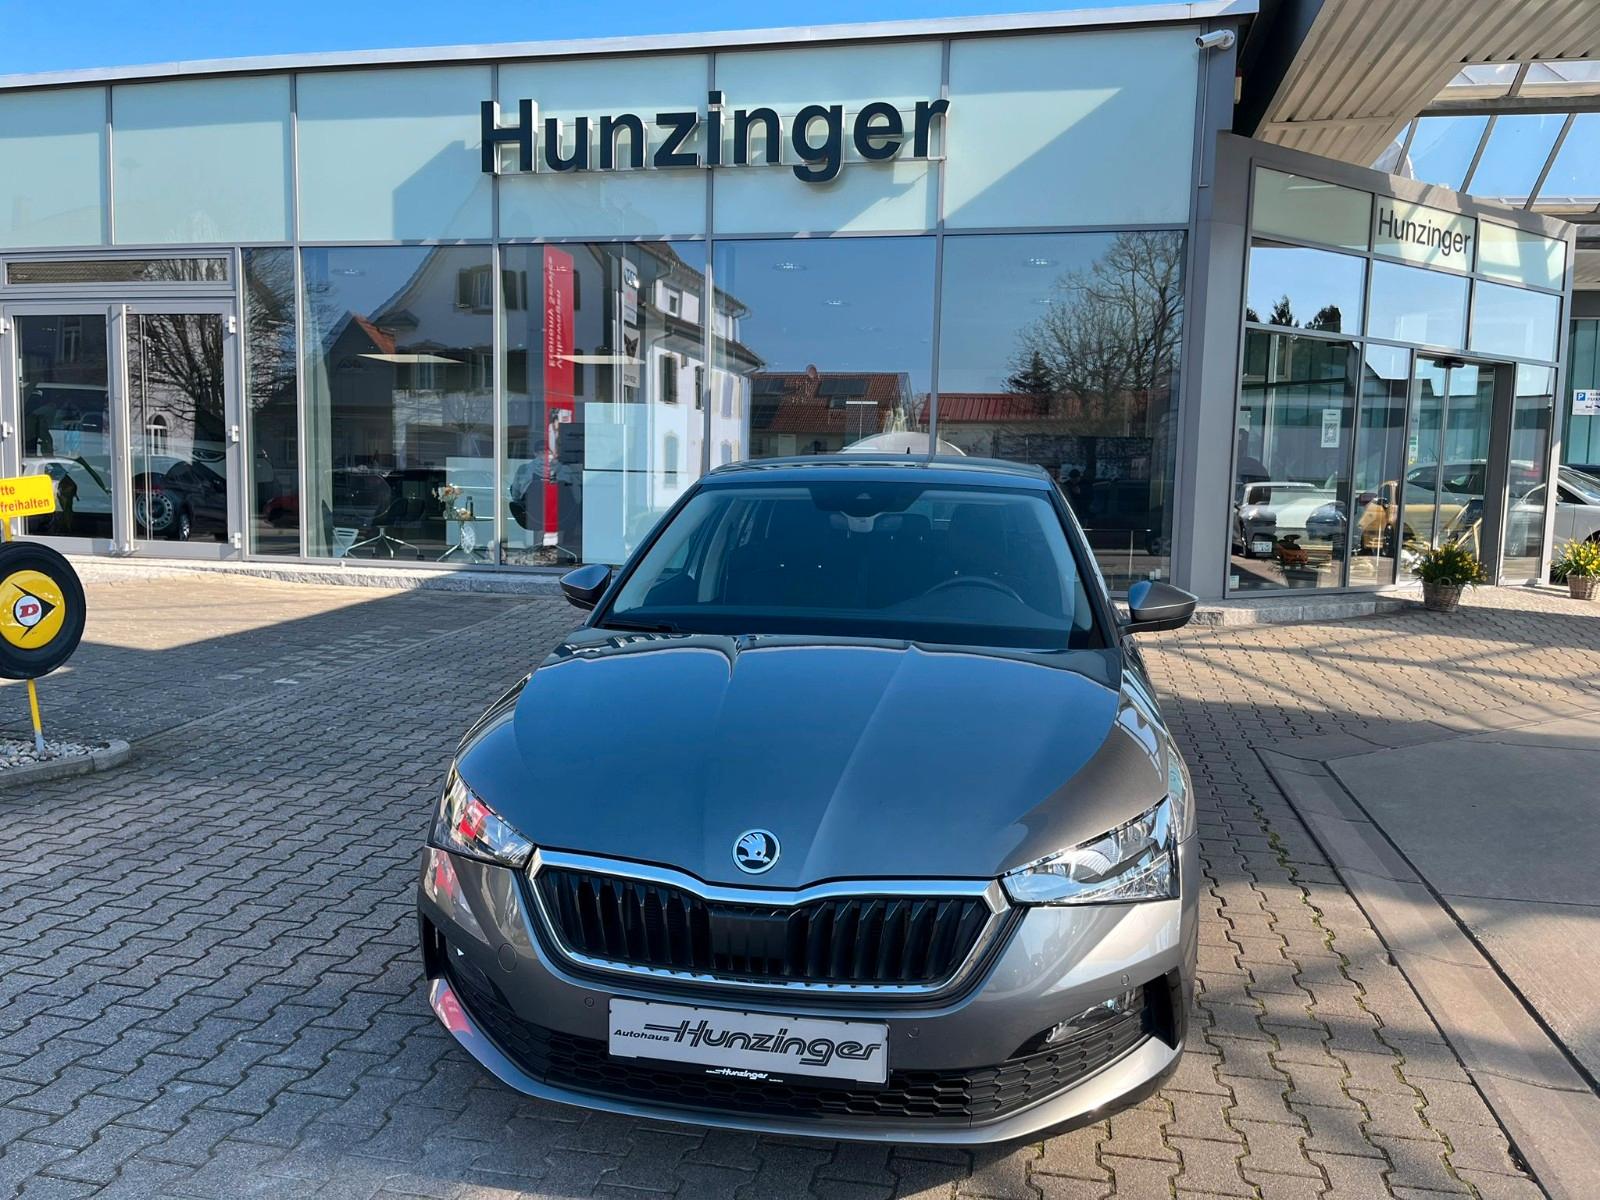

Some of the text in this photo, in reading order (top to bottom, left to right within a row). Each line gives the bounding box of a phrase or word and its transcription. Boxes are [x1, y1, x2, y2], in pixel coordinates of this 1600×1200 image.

[481, 91, 949, 183] Hunzinger
[1379, 207, 1471, 257] Hunzinger
[0, 499, 49, 512] freihalten
[20, 603, 40, 618] D
[614, 1020, 881, 1066] Autohaus Hunzinger
[715, 1068, 768, 1080] Hunzinger
